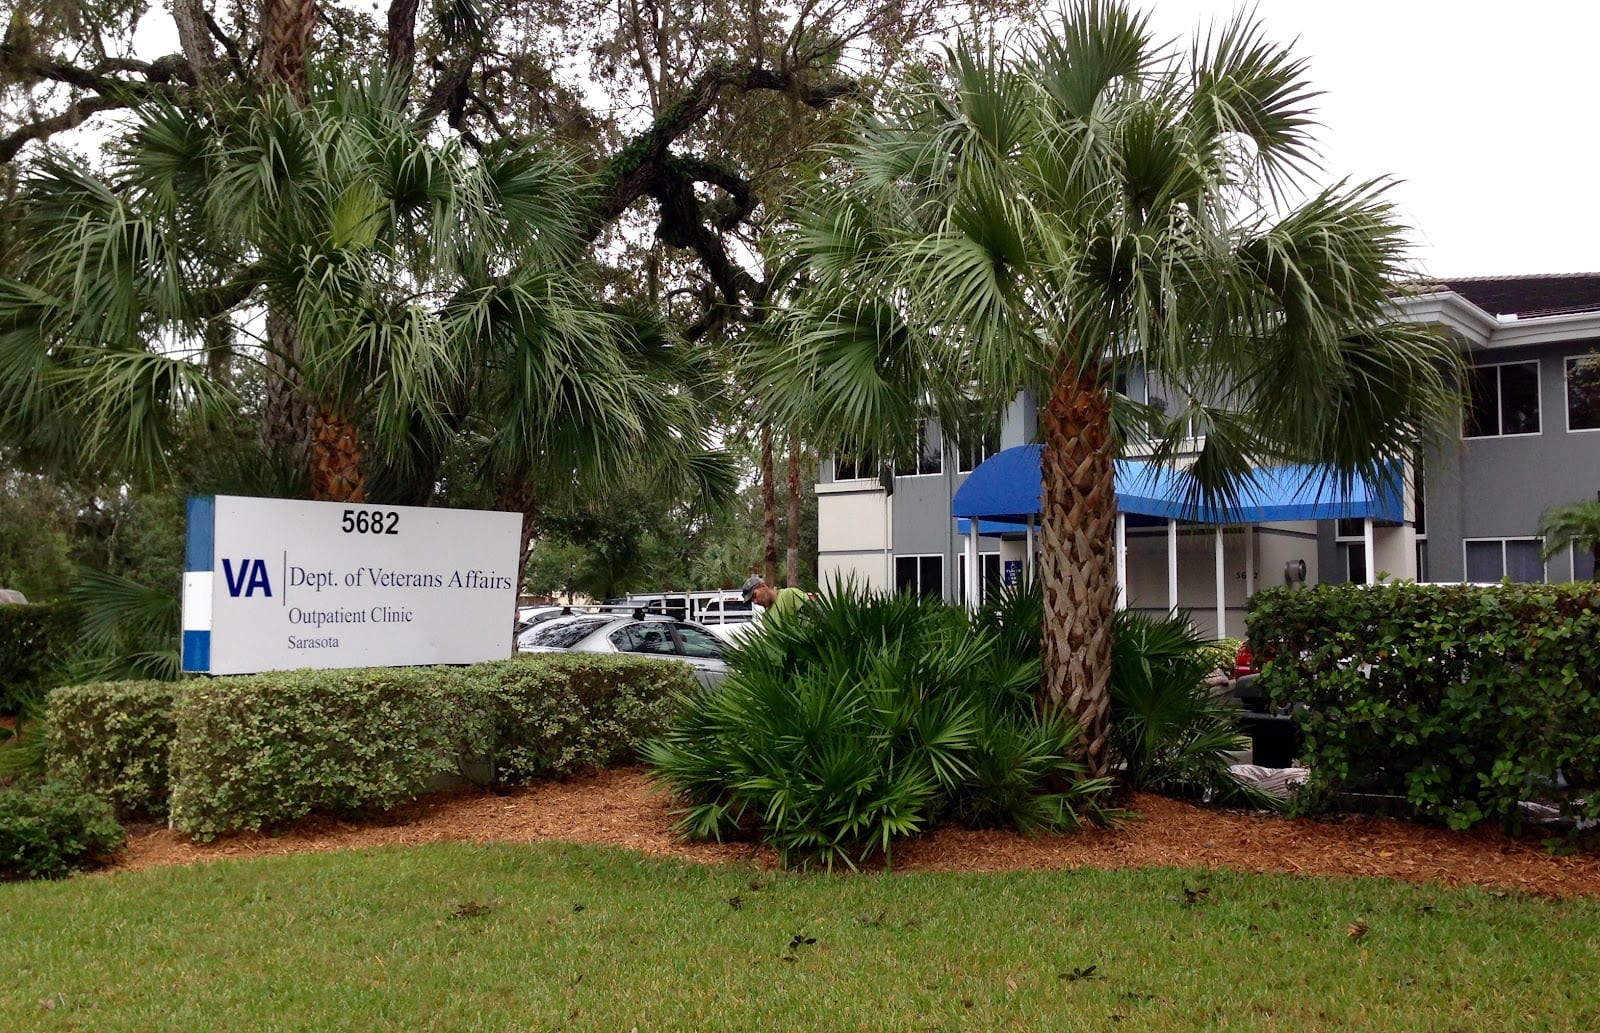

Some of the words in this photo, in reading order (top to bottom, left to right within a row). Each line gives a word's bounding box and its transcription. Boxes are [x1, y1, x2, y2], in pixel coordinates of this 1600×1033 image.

[342, 509, 400, 535] 5682
[221, 558, 273, 598] VA
[289, 566, 338, 592] Dept.
[345, 567, 366, 587] of
[367, 567, 443, 588] Veterans
[447, 569, 512, 590] Affairs
[1235, 571, 1258, 579] 562
[288, 606, 366, 629] Outpatient
[370, 606, 413, 624] Clinic
[287, 635, 339, 650] Sarasota
